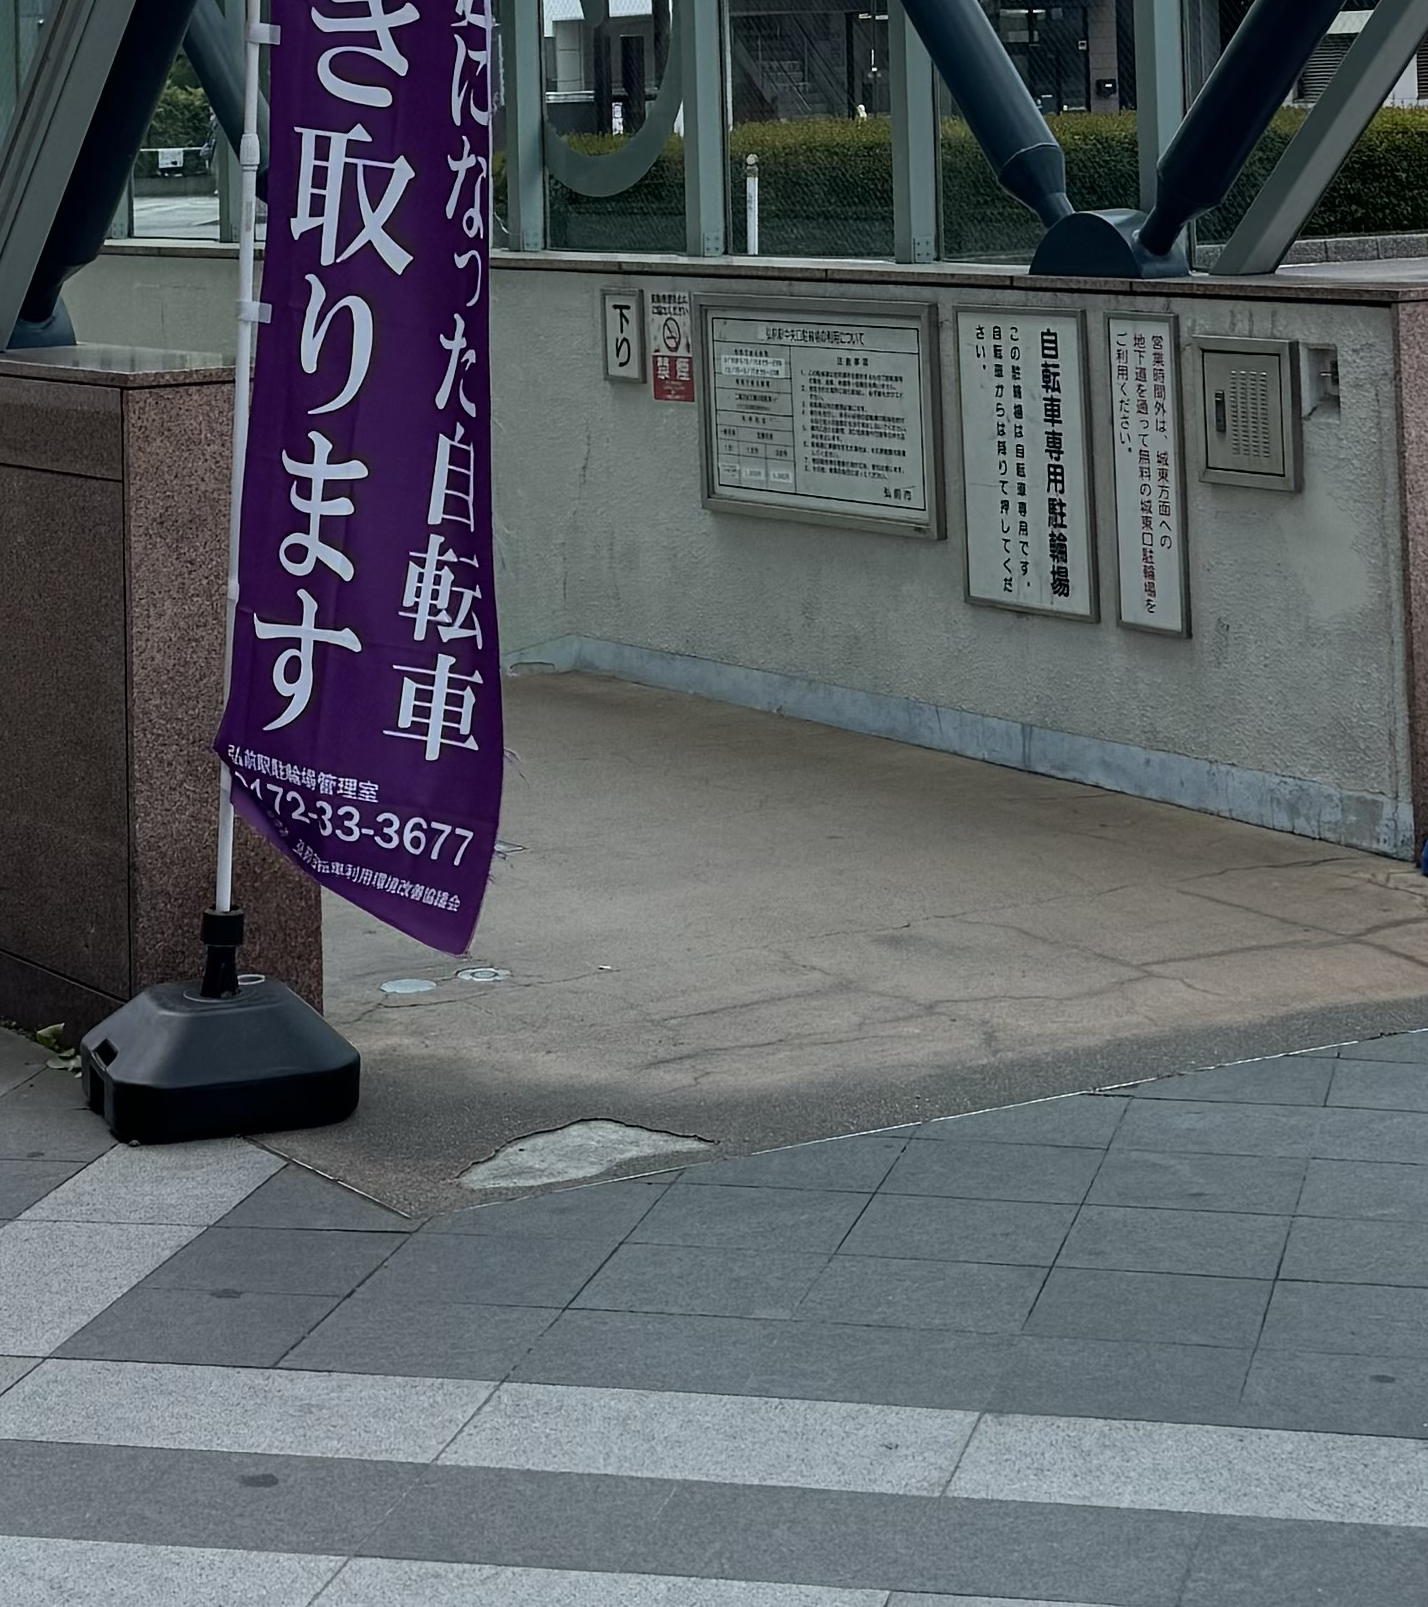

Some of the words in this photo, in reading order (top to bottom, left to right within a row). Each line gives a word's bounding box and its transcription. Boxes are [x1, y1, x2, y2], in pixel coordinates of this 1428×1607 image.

[612, 304, 631, 368] 下り
[975, 325, 987, 371] さい。
[1115, 332, 1133, 454] ご利用ください。
[1040, 328, 1070, 598] 自転車専用駐輪場
